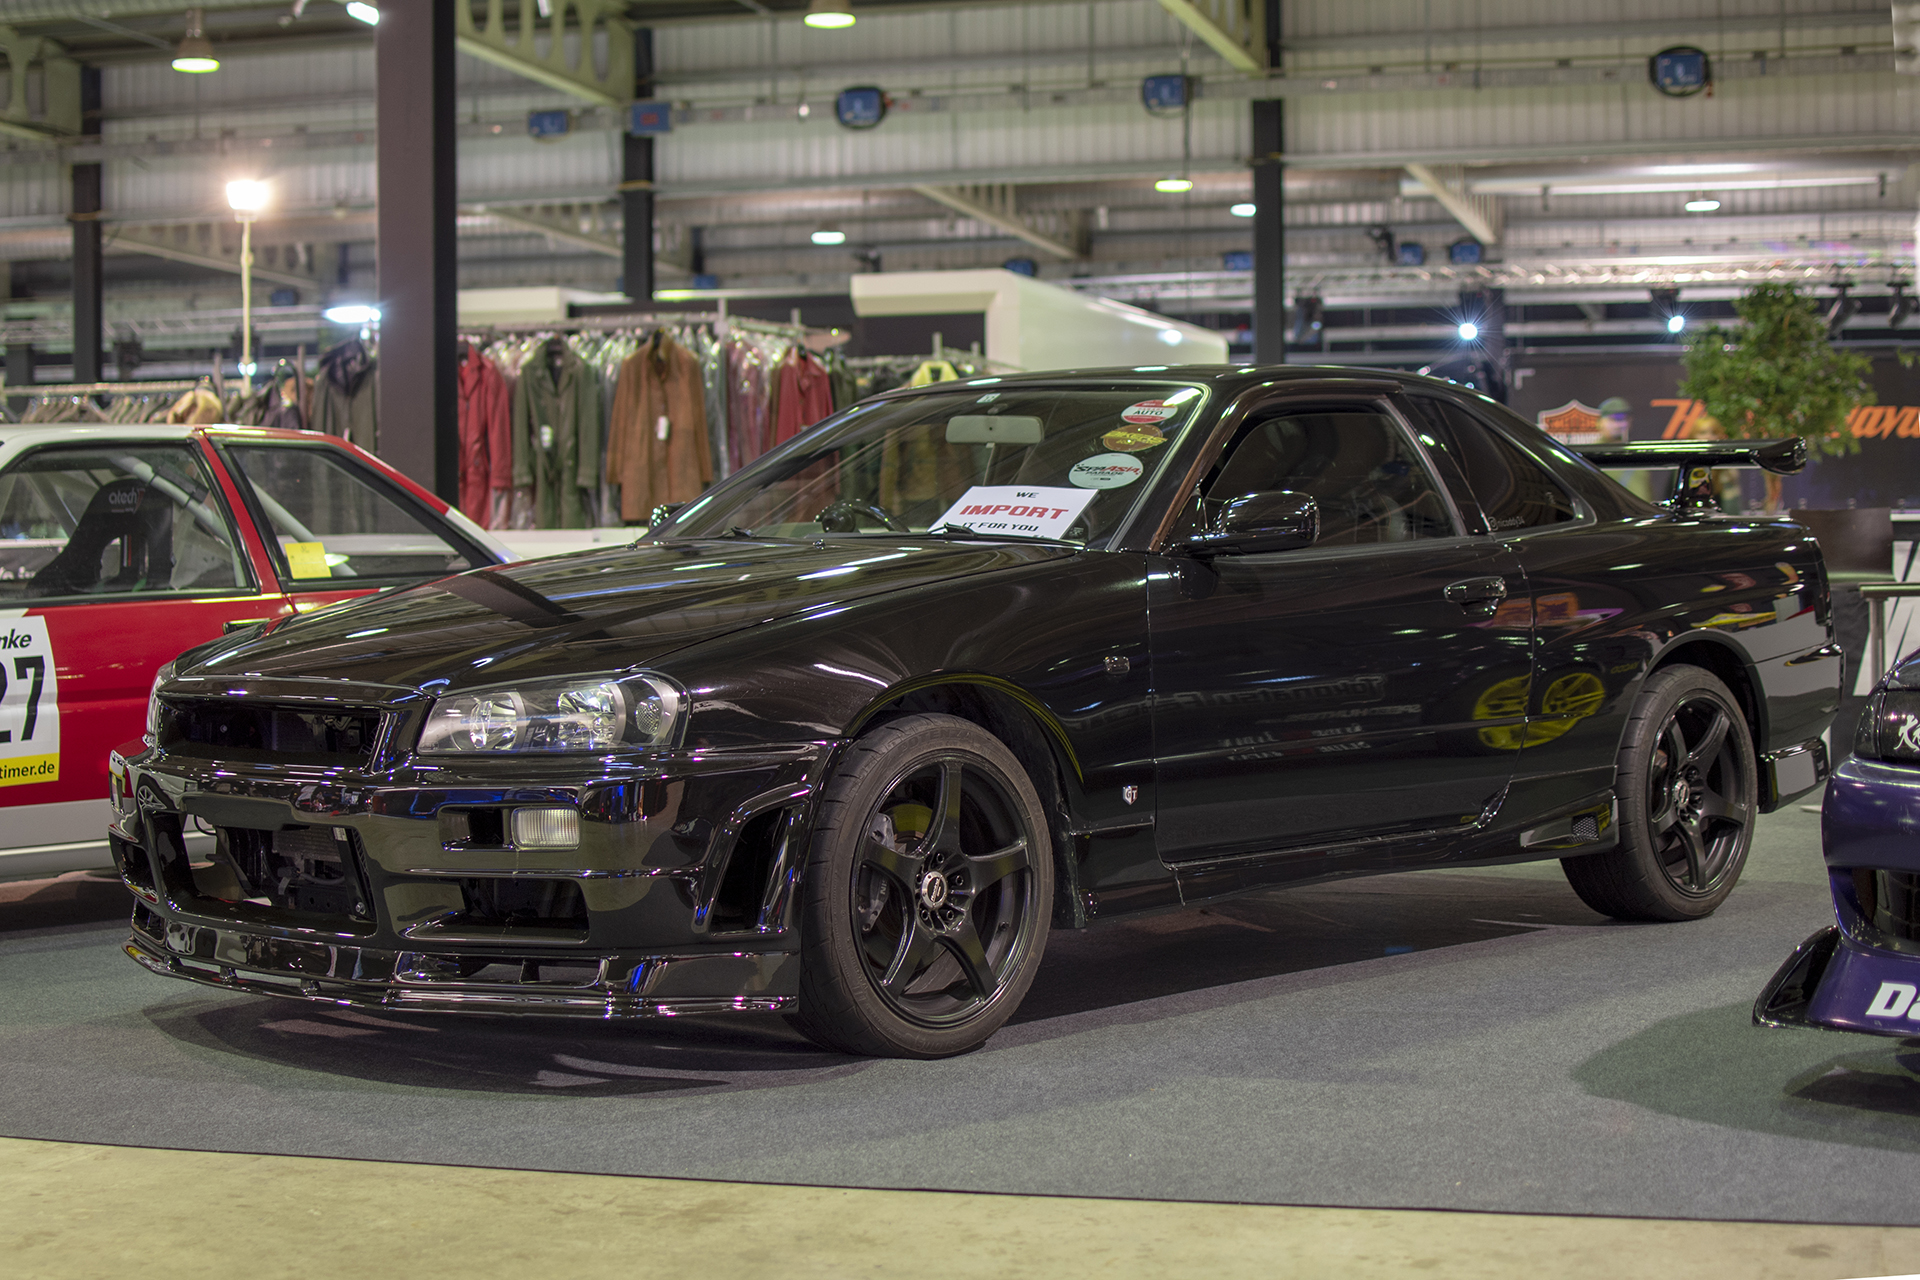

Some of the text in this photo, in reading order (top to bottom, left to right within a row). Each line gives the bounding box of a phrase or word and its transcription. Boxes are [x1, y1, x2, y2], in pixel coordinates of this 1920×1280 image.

[108, 487, 137, 504] atech
[959, 504, 1069, 519] IMPORT
[1011, 524, 1039, 532] YOU
